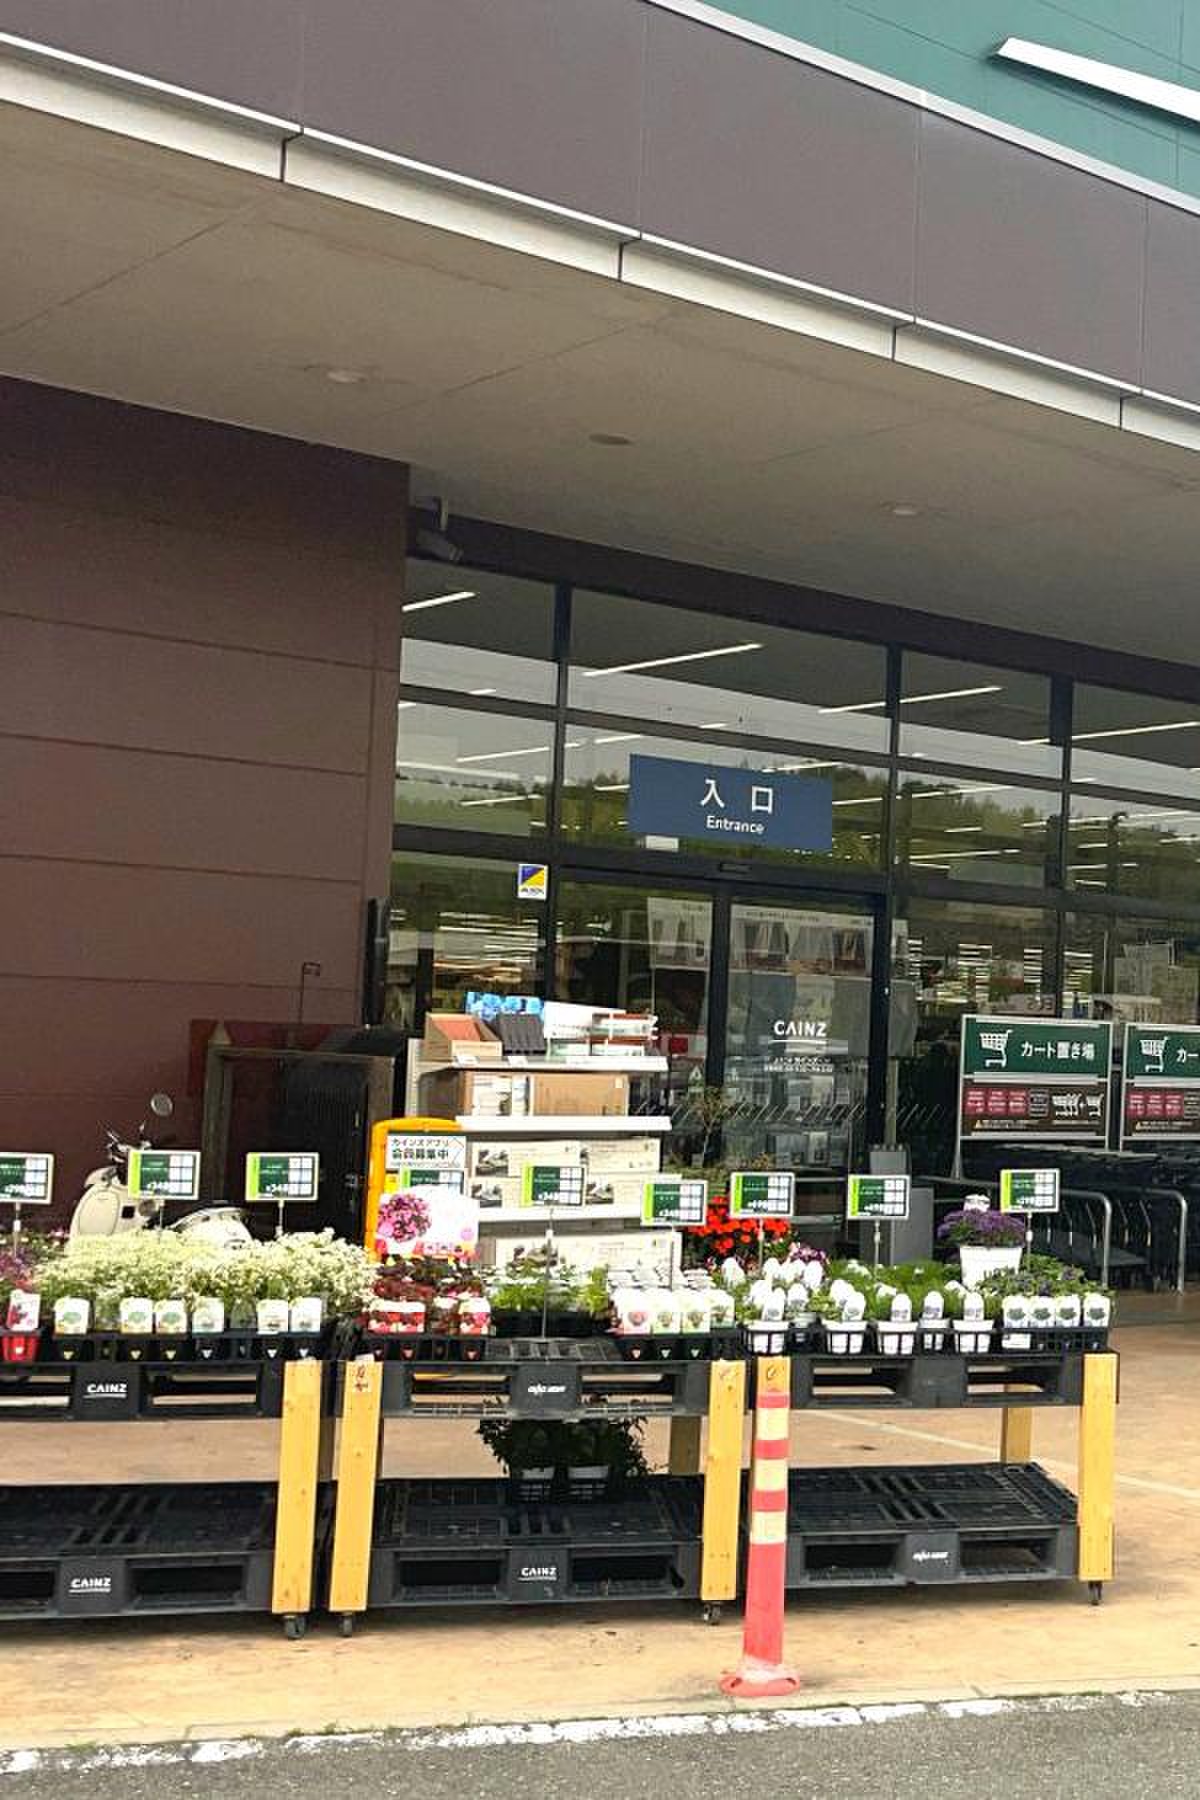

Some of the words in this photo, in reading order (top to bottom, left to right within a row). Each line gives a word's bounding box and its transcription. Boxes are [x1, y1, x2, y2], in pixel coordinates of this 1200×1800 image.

[701, 778, 774, 814] 入口
[706, 815, 765, 834] Entrance
[773, 1020, 827, 1037] CAINZ
[1021, 1041, 1095, 1061] カート置き場
[87, 1383, 127, 1393] CAINZ
[521, 1566, 557, 1577] CAINZ
[71, 1577, 111, 1588] CAINZ
